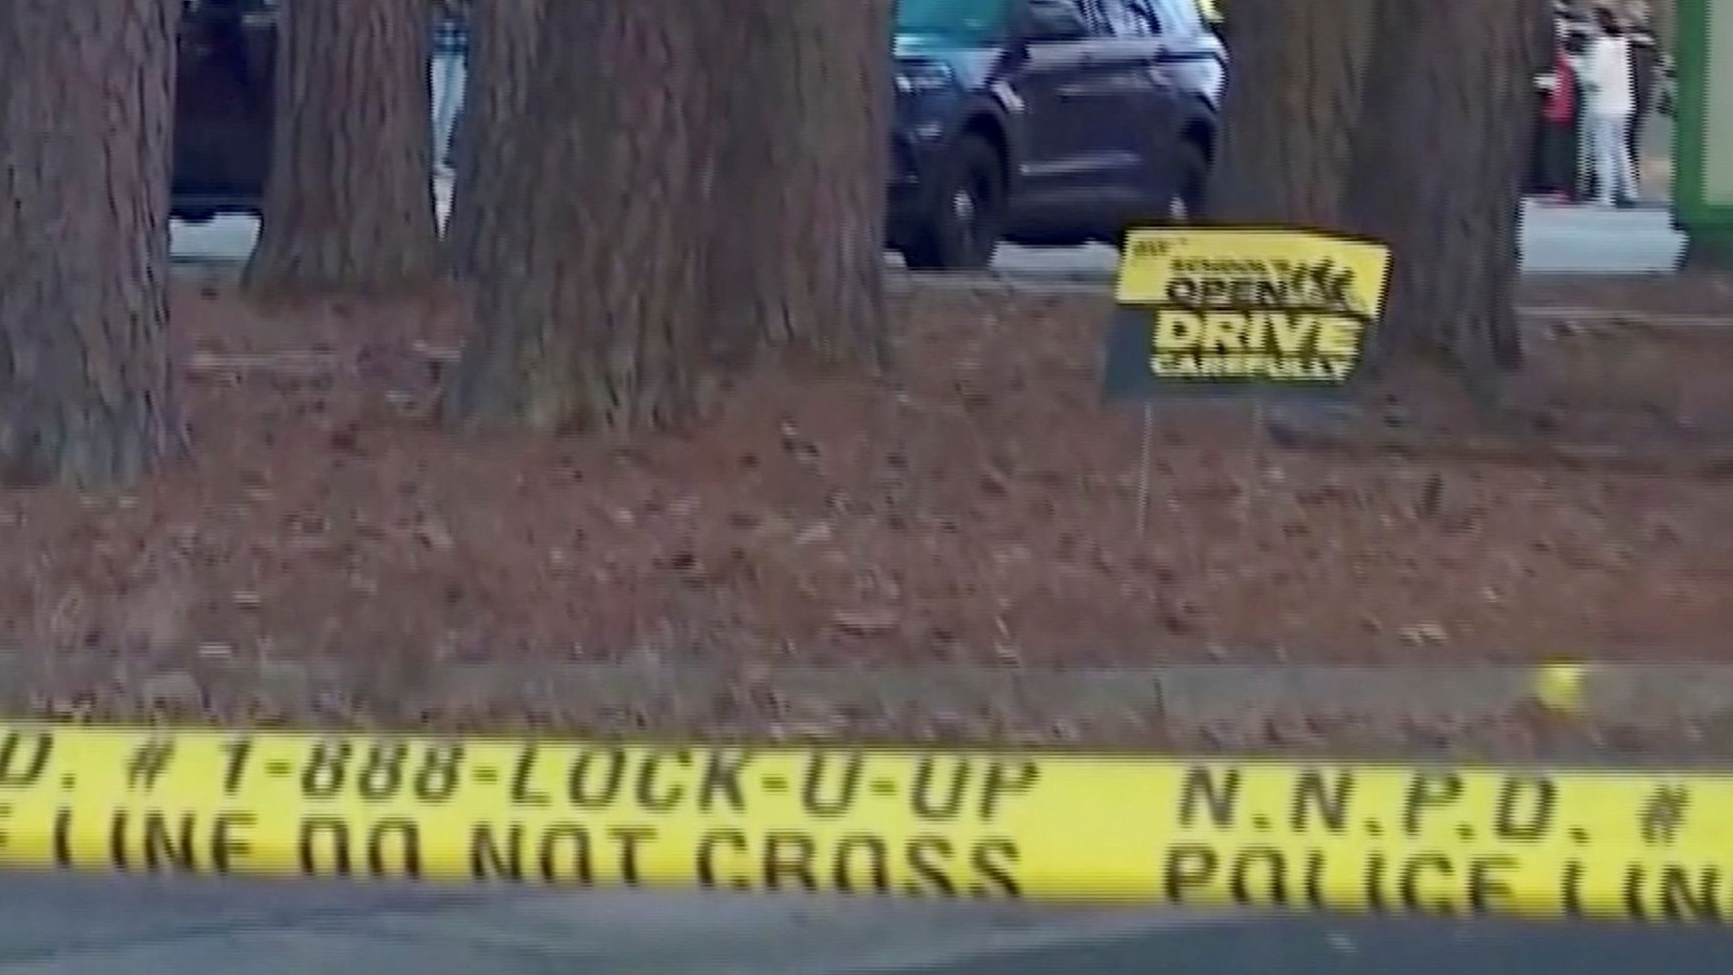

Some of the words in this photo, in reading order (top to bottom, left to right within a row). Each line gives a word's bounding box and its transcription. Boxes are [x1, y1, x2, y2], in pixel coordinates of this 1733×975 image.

[1166, 276, 1286, 305] OPEN
[1148, 354, 1352, 382] CAREFULLY
[1154, 310, 1364, 354] DRIVE
[218, 738, 1040, 820] 1-888-LOCK-U-UP
[1178, 764, 1591, 844] N.N.P.D.
[52, 806, 258, 876] LINE
[298, 814, 422, 882] DO
[472, 822, 658, 888] NOT
[696, 828, 1022, 900] CROSS
[1162, 842, 1520, 914] POLICE
[1560, 860, 1733, 922] LIN
